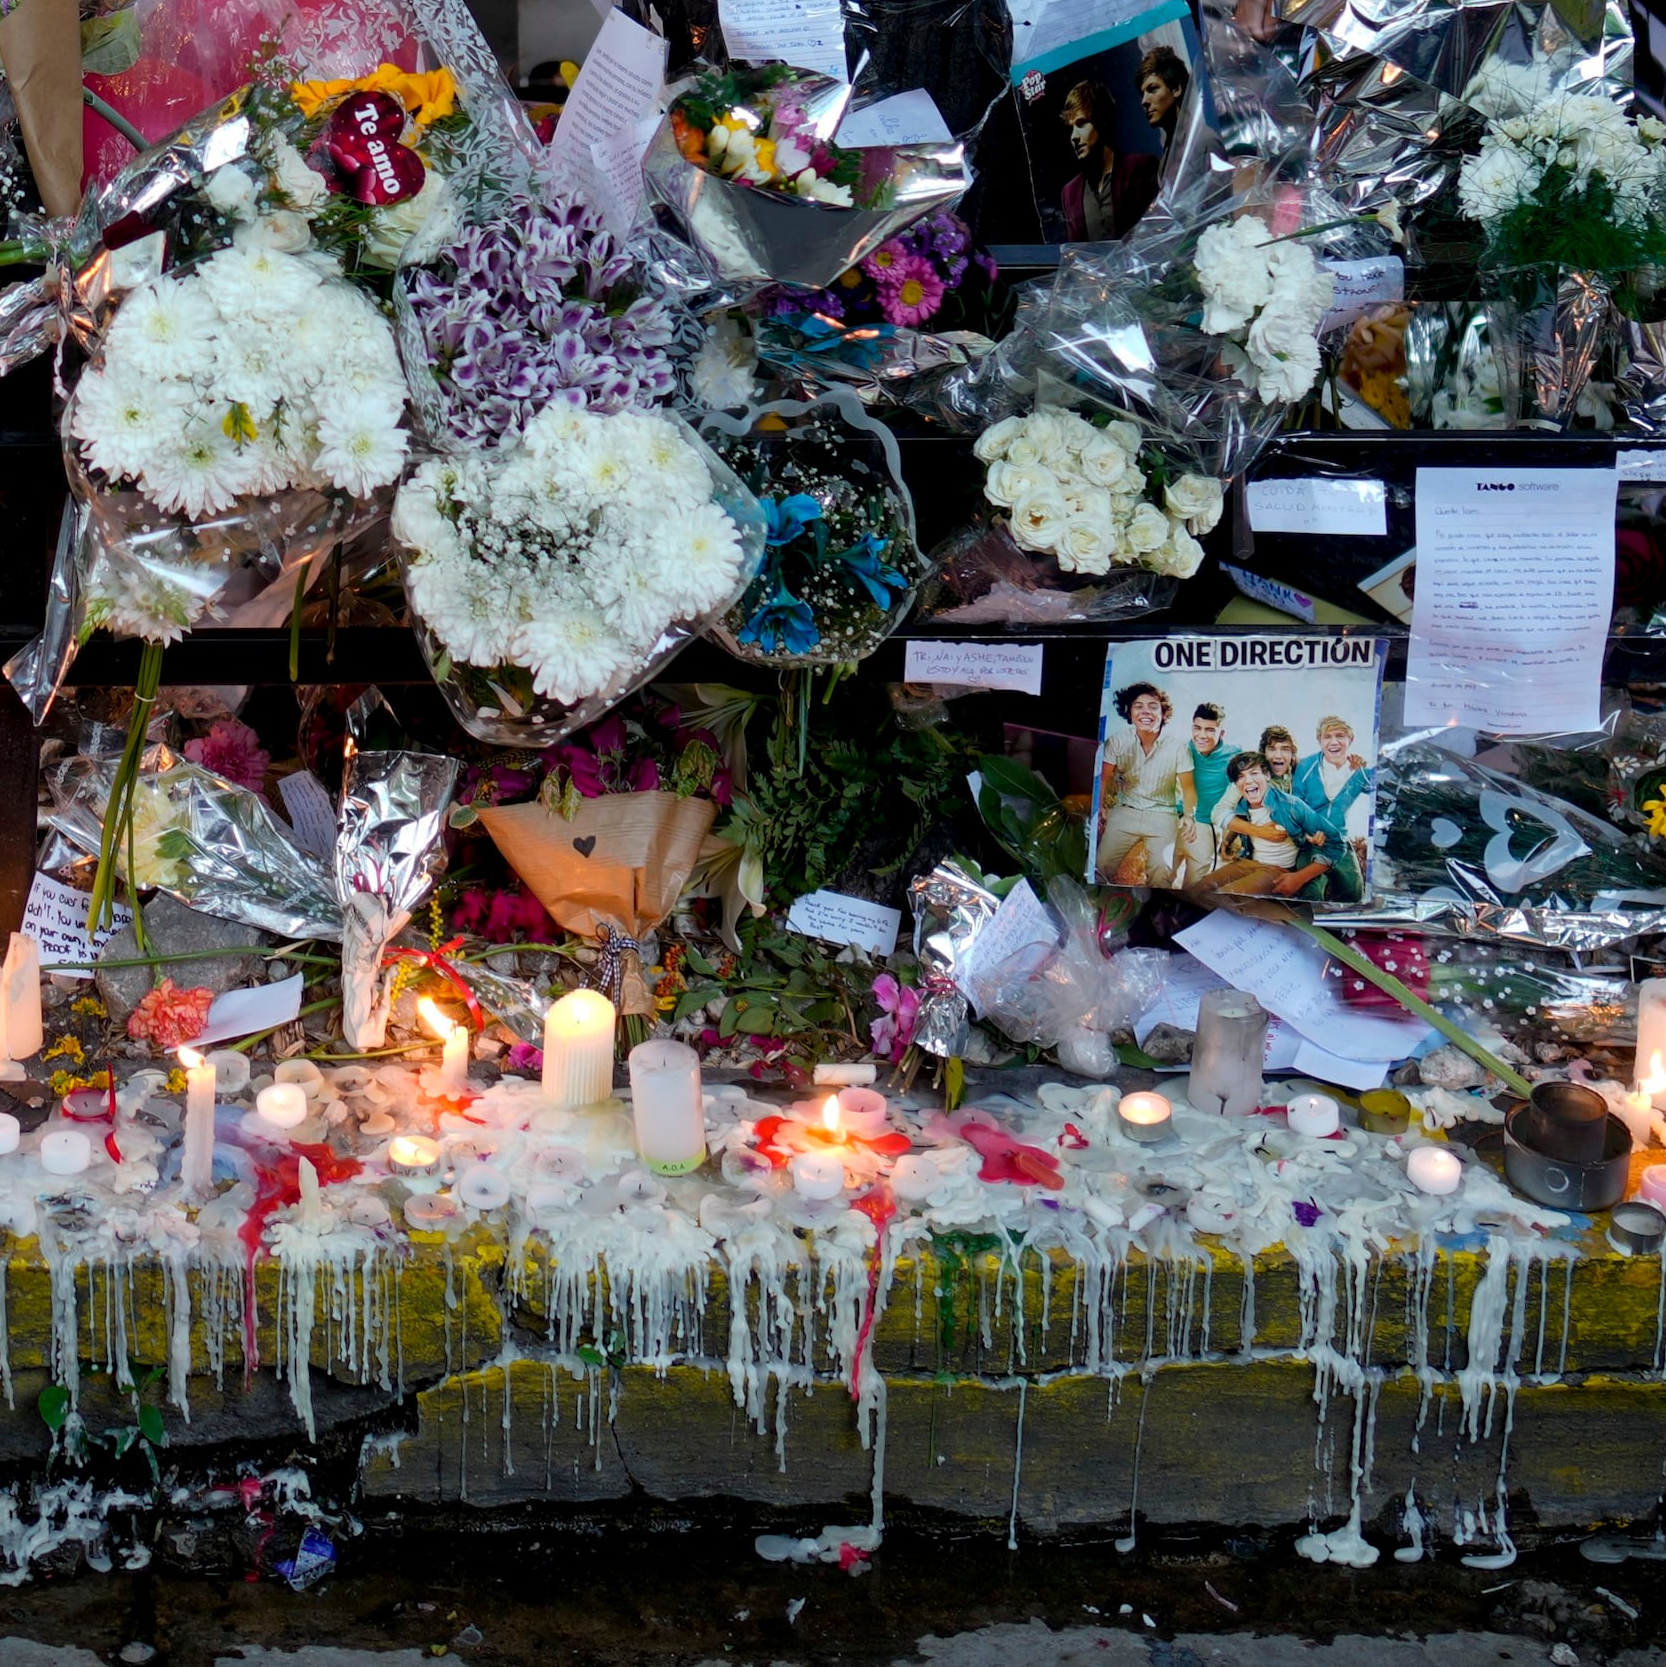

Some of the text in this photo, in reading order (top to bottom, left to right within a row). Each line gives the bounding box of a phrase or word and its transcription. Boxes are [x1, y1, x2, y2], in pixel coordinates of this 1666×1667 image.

[1022, 72, 1041, 88] Pop
[1024, 80, 1046, 100] Star
[354, 103, 400, 194] Te amo
[1476, 482, 1559, 492] TANGO software
[1254, 503, 1305, 511] SALUD
[1155, 640, 1371, 667] ONE DIRECTION
[42, 888, 55, 900] you
[25, 922, 36, 932] on
[40, 927, 58, 938] your
